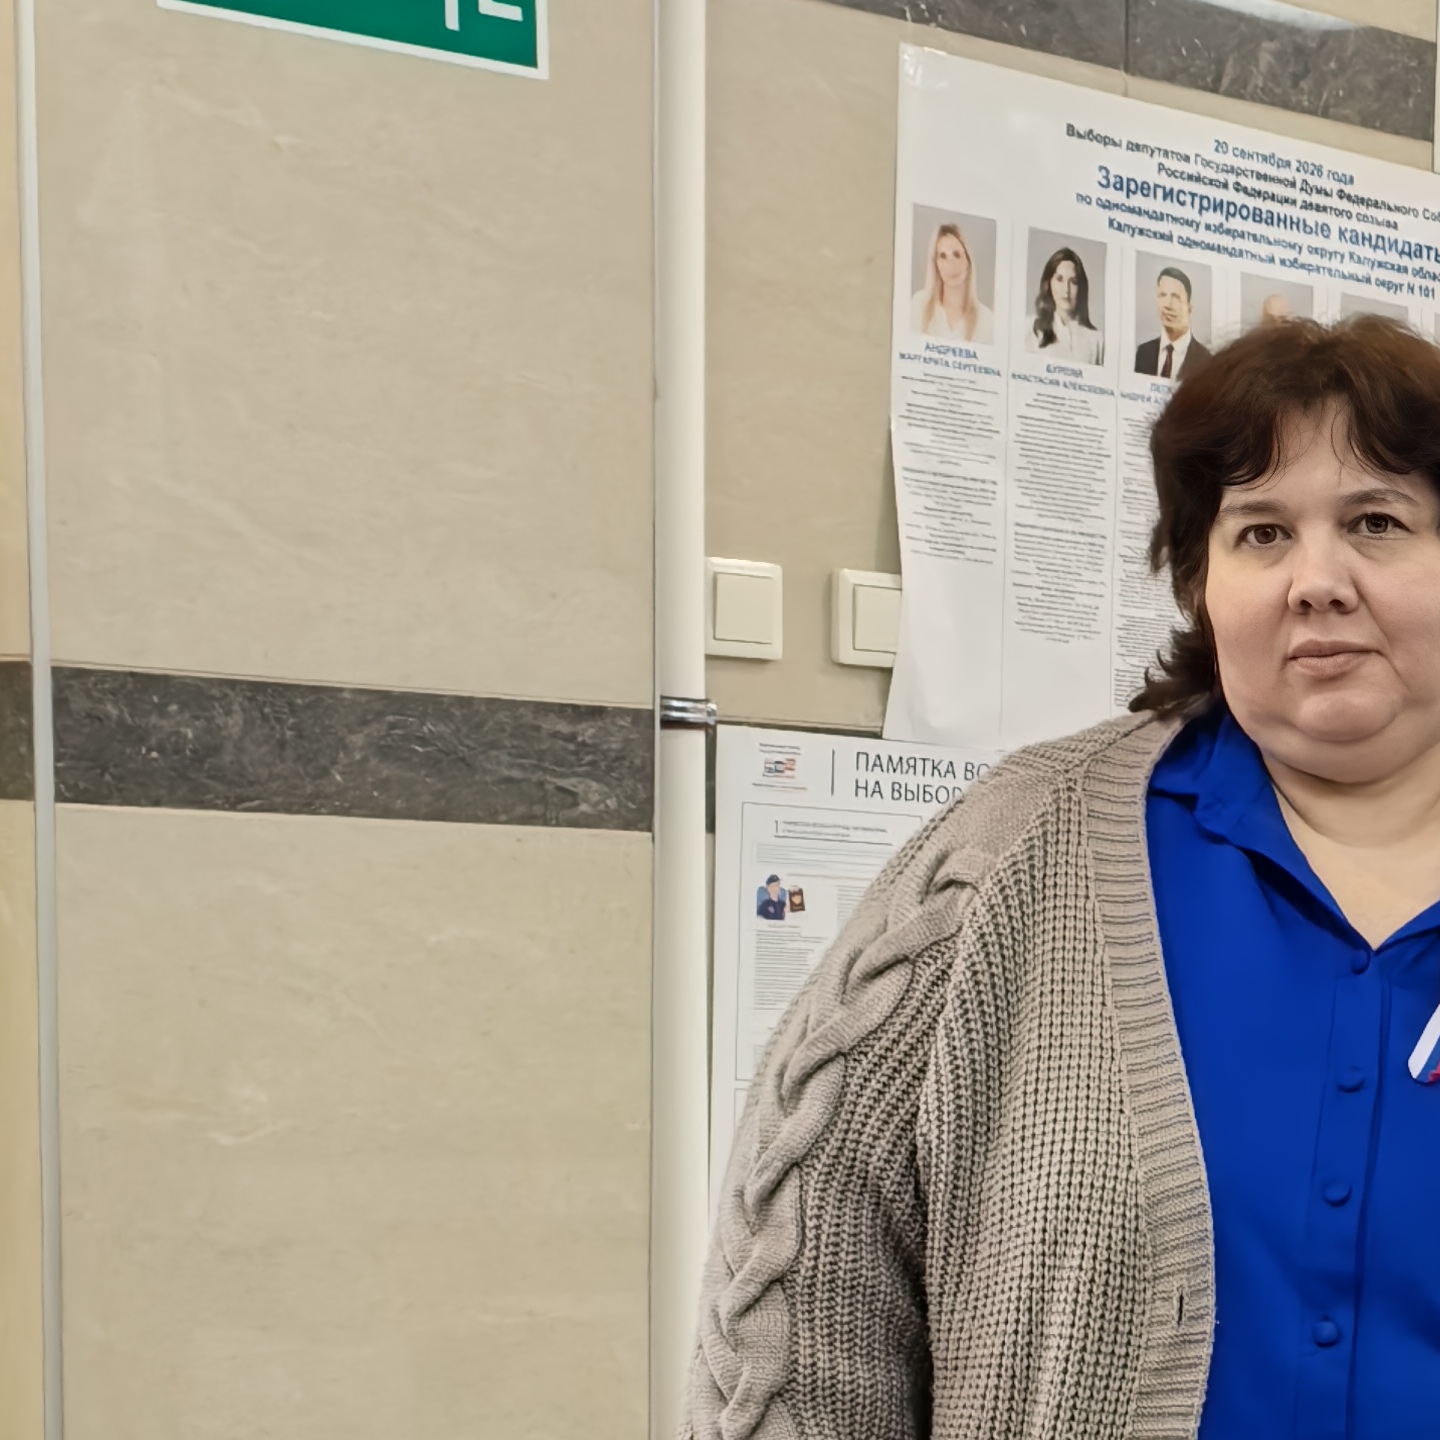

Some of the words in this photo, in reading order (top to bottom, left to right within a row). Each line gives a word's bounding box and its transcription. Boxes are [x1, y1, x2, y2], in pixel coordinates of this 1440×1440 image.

[1214, 139, 1229, 157] 20
[1097, 165, 1332, 244] Зарегистрированные
[856, 751, 957, 780] ПАМЯТКА
[854, 778, 884, 800] НА
